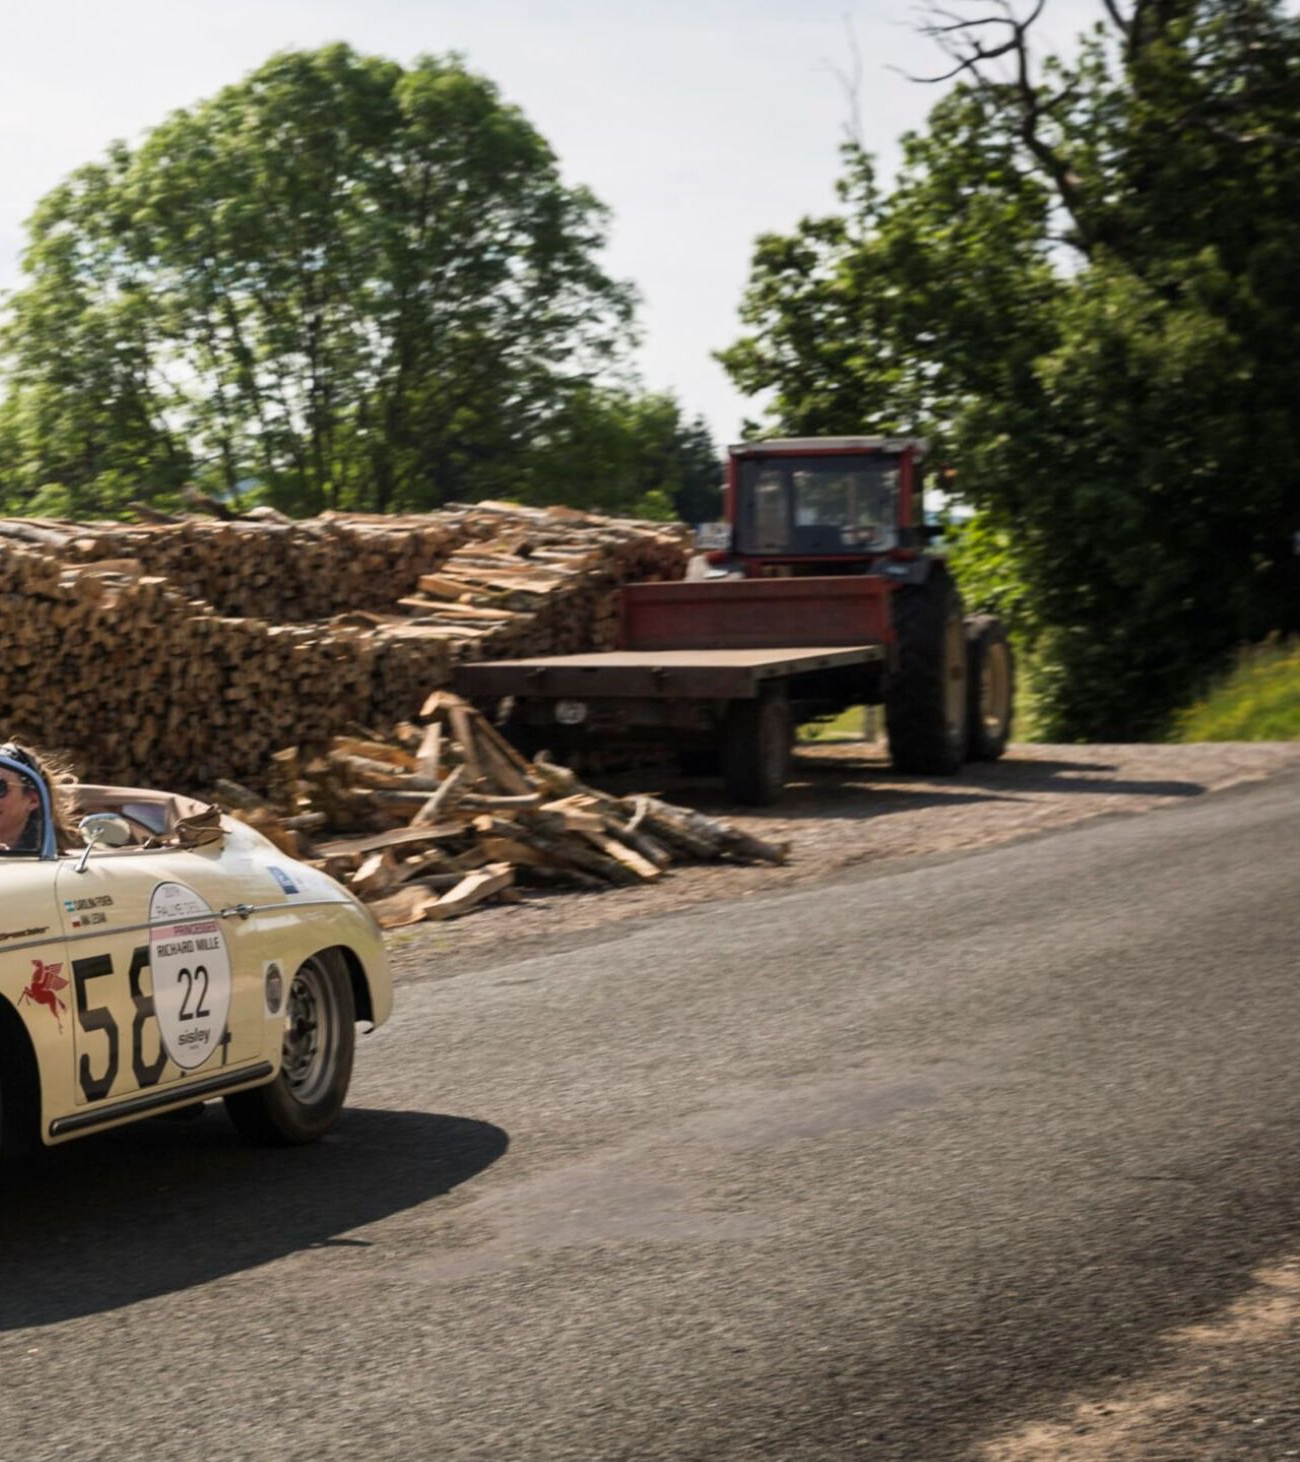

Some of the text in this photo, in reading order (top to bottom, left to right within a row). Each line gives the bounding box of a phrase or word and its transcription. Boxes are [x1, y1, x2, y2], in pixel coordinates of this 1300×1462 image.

[157, 936, 220, 957] RICHARD MILLE
[177, 965, 210, 1021] 22
[178, 1027, 211, 1045] sisley
